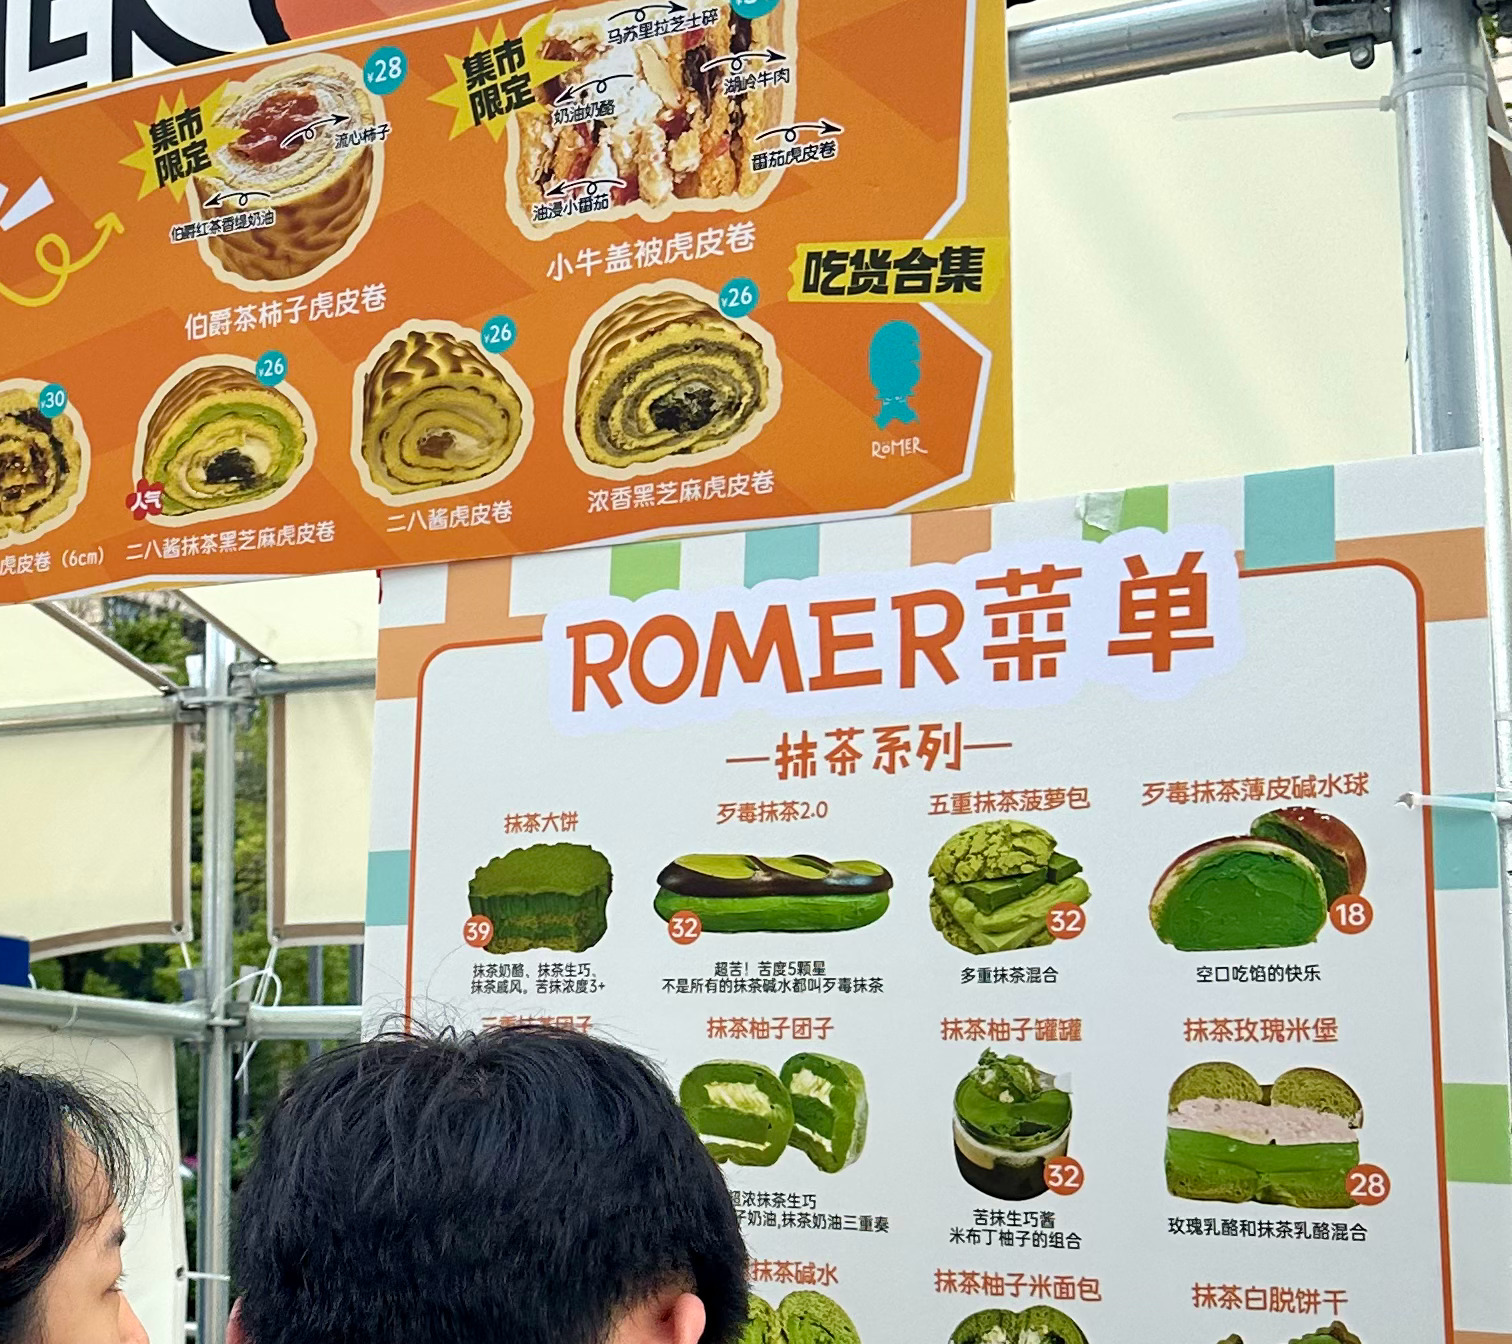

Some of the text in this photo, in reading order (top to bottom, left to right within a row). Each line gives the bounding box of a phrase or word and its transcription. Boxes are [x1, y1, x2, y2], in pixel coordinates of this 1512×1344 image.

[607, 8, 719, 44] 马苏里拉芝士碎
[463, 38, 525, 90] 集市
[470, 75, 536, 126] 限定
[554, 99, 615, 126] 奶油奶酪
[149, 106, 203, 149] 集市
[334, 125, 390, 148] 流心柿子
[155, 141, 211, 188] 限定
[752, 142, 836, 171] 番茄虎皮卷
[534, 194, 609, 222] 油浸小番茄
[546, 221, 756, 281] 小牛盖被虎皮卷
[802, 246, 985, 295] 吃货合集
[185, 283, 386, 340] 伯爵茶柿子虎皮卷
[131, 490, 162, 510] 人气
[587, 470, 775, 514] 浓香黑芝麻虎皮卷
[387, 500, 513, 534] 二八酱虎皮卷
[126, 520, 336, 561] 二八酱抹茶黑芝麻虎皮卷
[929, 787, 1090, 816] 五重抹茶菠萝包
[1141, 772, 1369, 807] 歹毒抹茶薄皮碱水球
[504, 811, 579, 834] 抹茶大饼
[716, 801, 828, 825] 歹毒抹茶2.0
[1050, 911, 1081, 932] 32
[1336, 903, 1365, 926] 18
[465, 921, 491, 942] 39
[670, 918, 699, 939] 32
[661, 977, 884, 994] 不是所有的抹茶碱水都叫歹毒抹茶
[961, 966, 1059, 984] 多重抹茶混合
[1196, 964, 1321, 983] 空口吃馅的快乐
[707, 1017, 834, 1039] 抹茶柚子团子
[940, 1017, 1082, 1042] 抹茶柚子罐罐
[1183, 1017, 1339, 1043] 抹茶玫瑰米堡
[1049, 1164, 1079, 1188] 32
[1349, 1173, 1386, 1197] 28
[973, 1209, 1055, 1228] 苦抹生巧酱
[1167, 1217, 1368, 1242] 玫瑰乳酪和抹茶乳酪混合
[950, 1227, 1082, 1250] 米布丁柚子的组合
[750, 1258, 839, 1286] 抹茶碱水
[934, 1268, 1102, 1302] 抹茶柚子米面包
[1192, 1283, 1348, 1316] 抹茶白脱饼干
